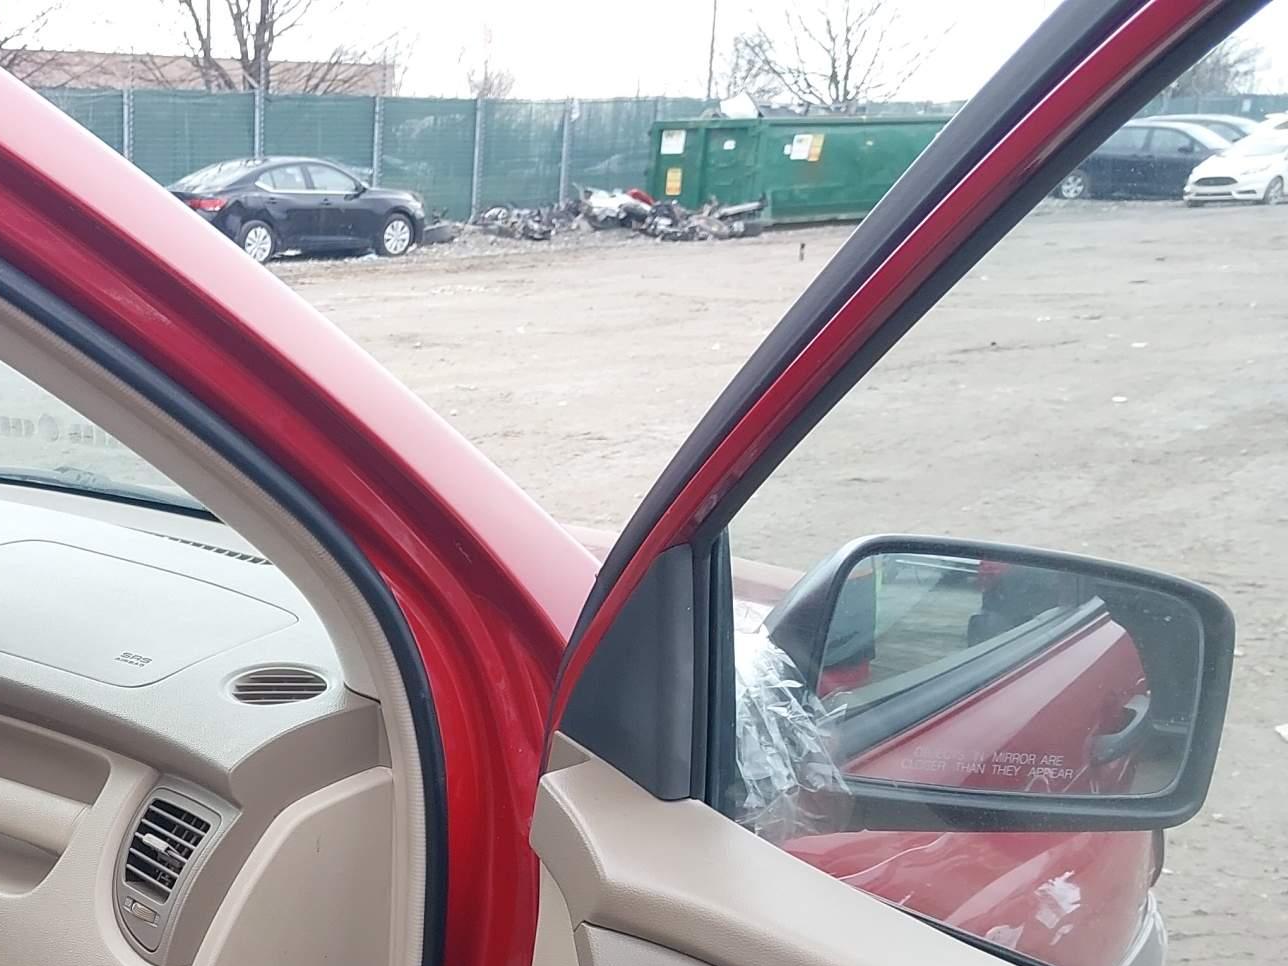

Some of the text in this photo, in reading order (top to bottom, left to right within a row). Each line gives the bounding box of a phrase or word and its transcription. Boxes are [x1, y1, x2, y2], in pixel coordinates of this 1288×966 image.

[119, 652, 153, 664] SRS
[992, 752, 1036, 765] MIRROR
[1040, 755, 1064, 767] ARE
[955, 762, 986, 775] THAN
[991, 764, 1021, 777] THEY
[1028, 766, 1074, 779] APPEAR
